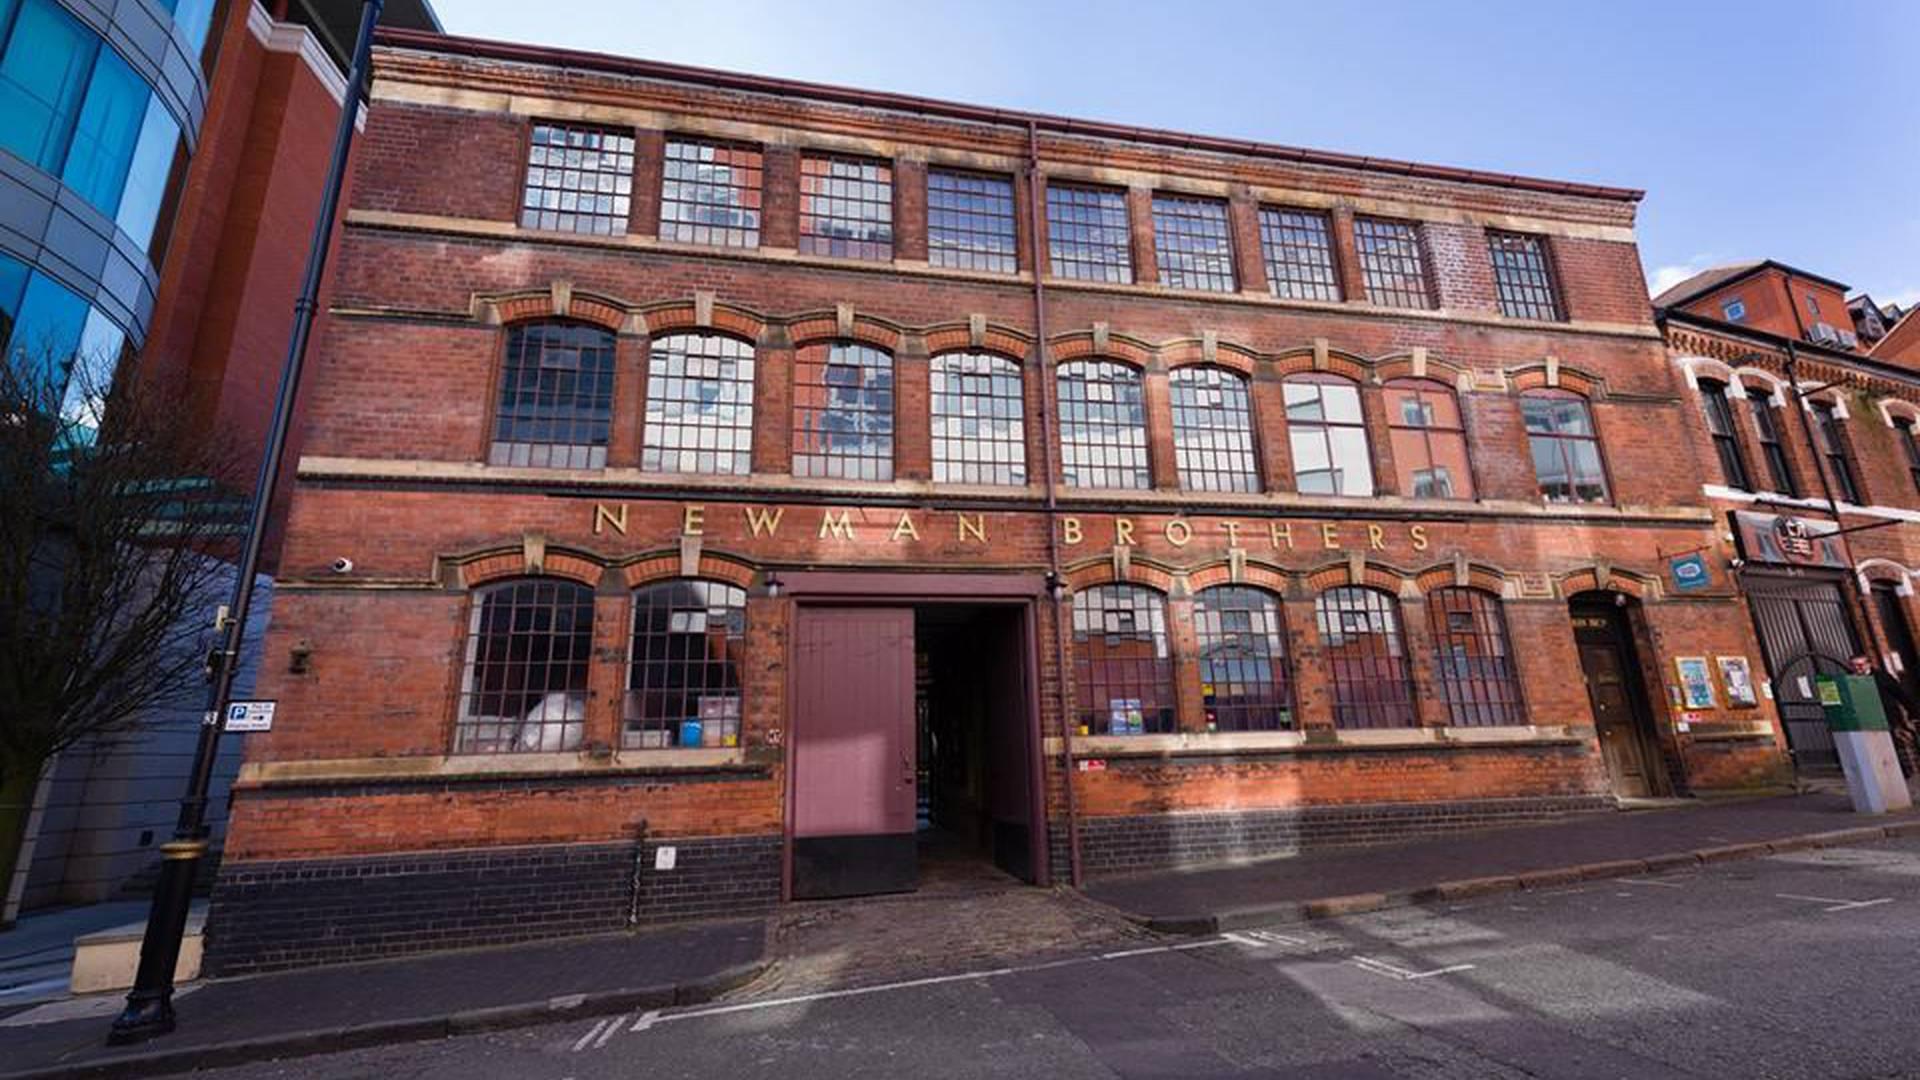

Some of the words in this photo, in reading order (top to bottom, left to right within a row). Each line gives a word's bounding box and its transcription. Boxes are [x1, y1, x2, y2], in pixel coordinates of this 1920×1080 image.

[593, 502, 987, 543] NEWMAN
[1063, 517, 1429, 551] BROTHERS
[233, 707, 245, 720] P
